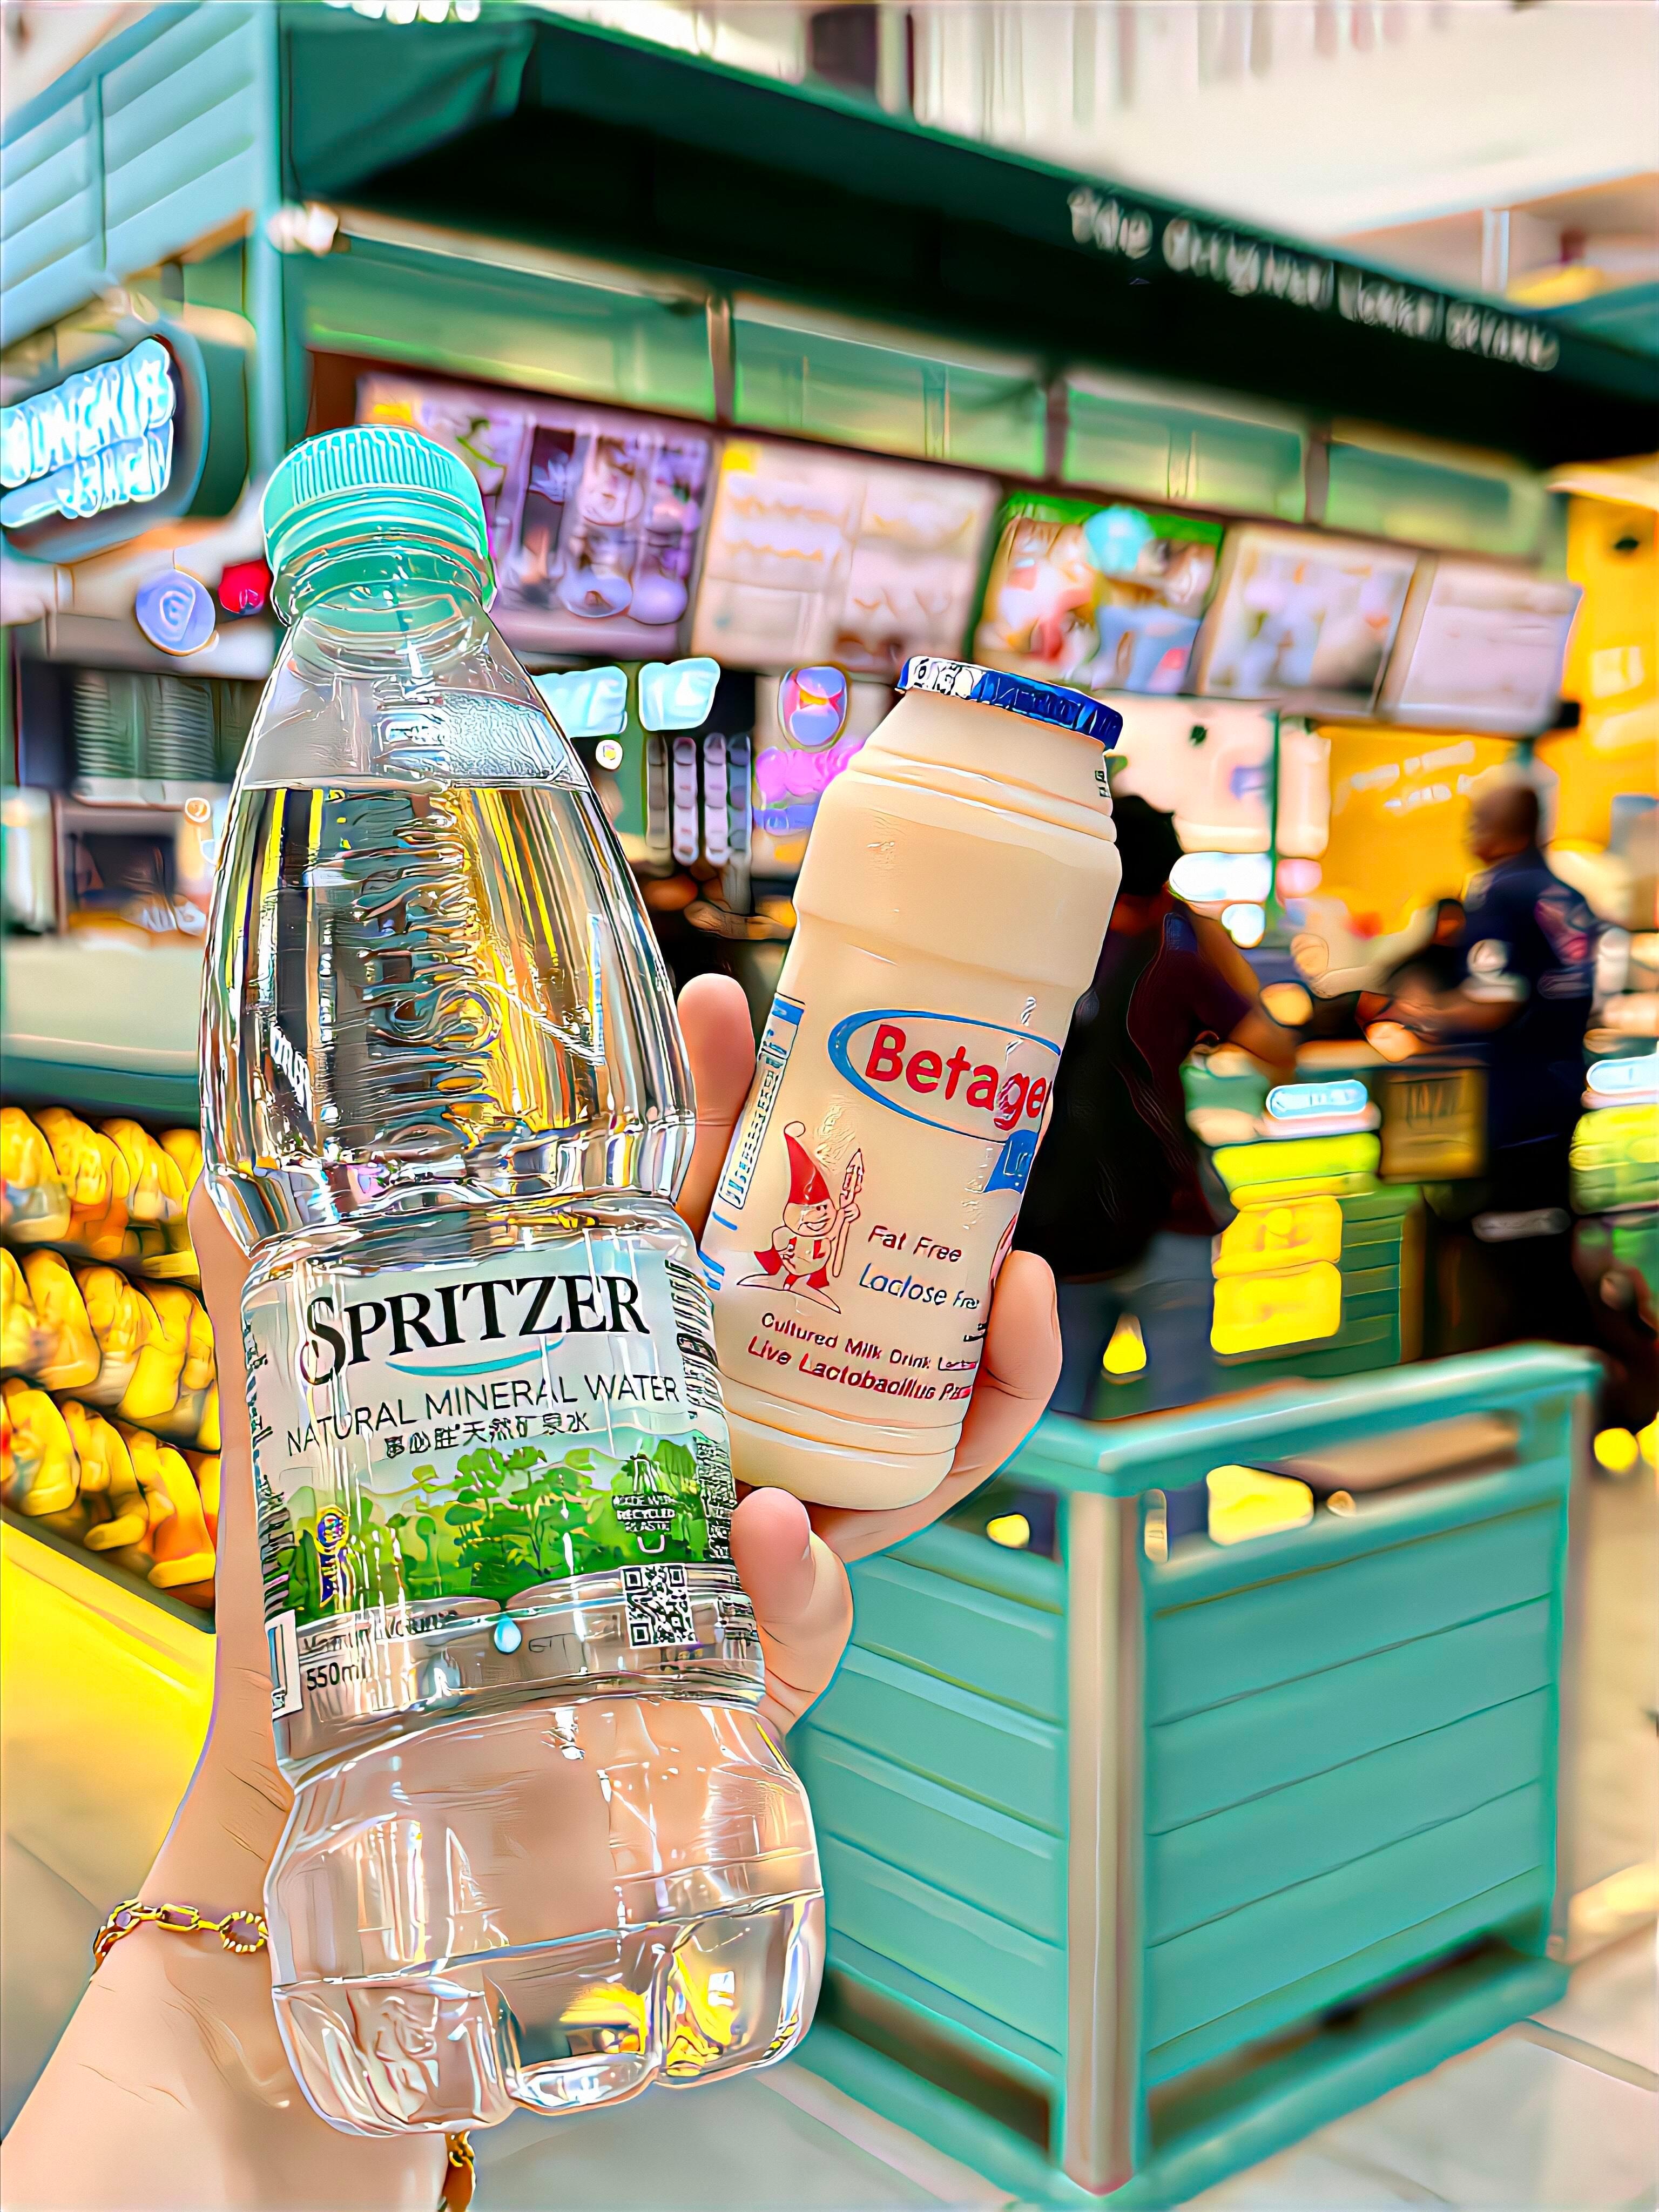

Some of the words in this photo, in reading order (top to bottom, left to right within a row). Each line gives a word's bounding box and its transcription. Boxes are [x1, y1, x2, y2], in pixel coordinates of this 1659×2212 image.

[865, 1024, 1052, 1131] Betage
[868, 1225, 907, 1250] Fat
[913, 1236, 963, 1263] Free
[859, 1263, 947, 1306] Lactose
[301, 1274, 651, 1386] SPRITZER
[761, 1312, 838, 1348] Cultured
[845, 1338, 882, 1359] Milk
[889, 1348, 930, 1370] Drink
[747, 1335, 792, 1365] Live
[798, 1352, 936, 1400] Lactobacillus
[287, 1399, 420, 1457] NATURAL
[425, 1375, 579, 1420] MINERAL
[583, 1373, 683, 1402] WATER
